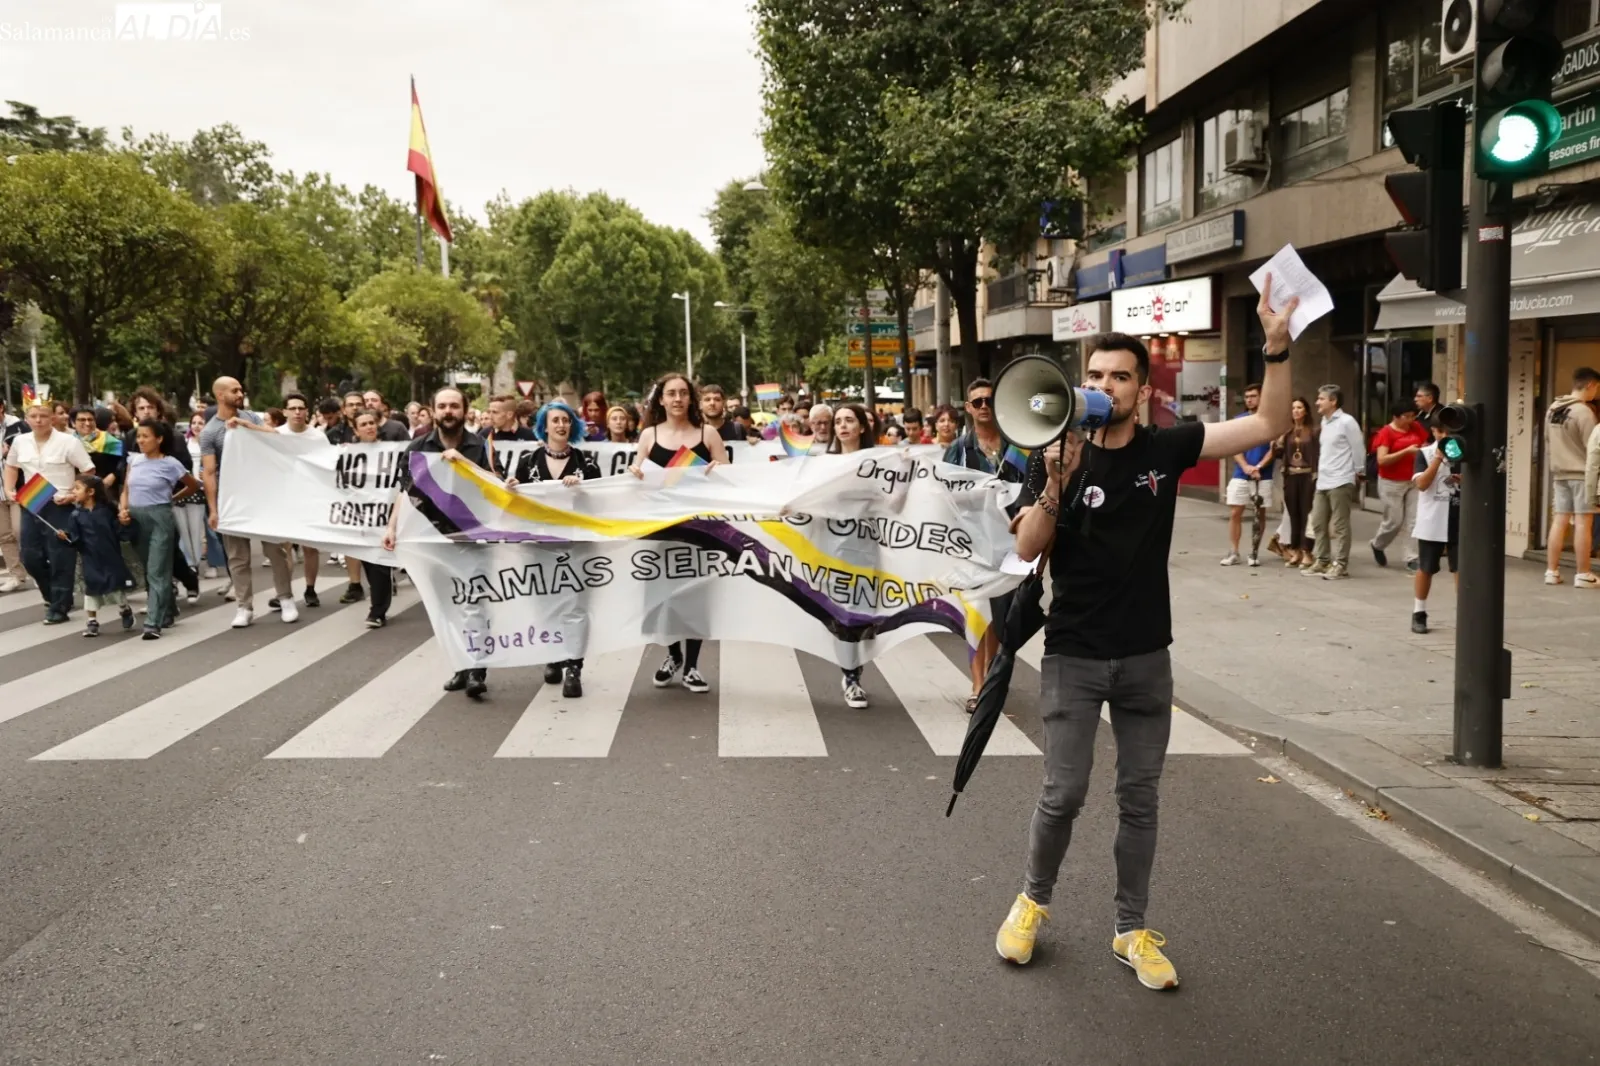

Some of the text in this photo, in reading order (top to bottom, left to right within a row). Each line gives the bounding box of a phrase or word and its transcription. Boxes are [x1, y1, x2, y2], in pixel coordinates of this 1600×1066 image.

[1560, 104, 1596, 131] artín
[1549, 142, 1588, 161] sesores
[336, 451, 406, 489] NO HA
[452, 552, 614, 605] JAMÁS
[631, 542, 793, 583] SERÁN
